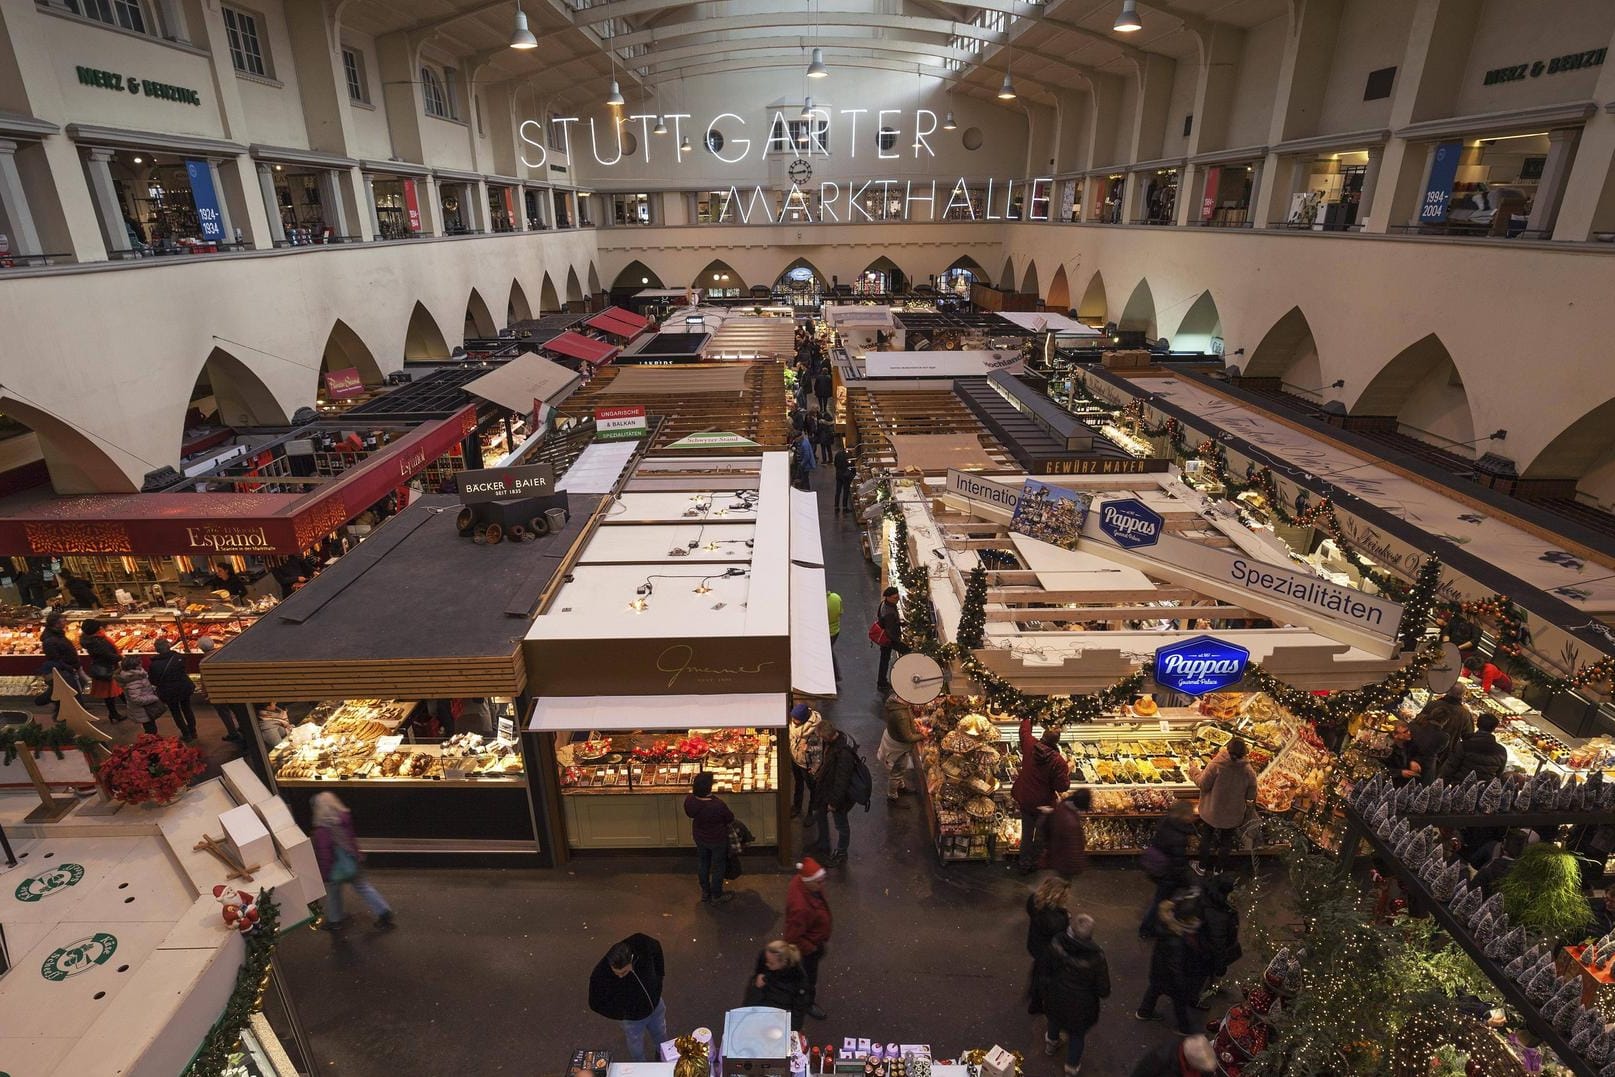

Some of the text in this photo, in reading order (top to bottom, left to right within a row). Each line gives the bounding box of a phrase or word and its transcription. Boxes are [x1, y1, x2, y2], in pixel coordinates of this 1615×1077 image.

[1483, 64, 1529, 85] MERZ
[1530, 61, 1545, 77] &
[76, 65, 201, 107] MERZ & BENZING
[519, 109, 938, 168] STUTTGARTER
[719, 176, 1053, 224] MARKTHALLE
[1426, 190, 1449, 203] 1994-
[199, 208, 220, 221] 1924-
[1422, 204, 1443, 217] 2004
[202, 222, 220, 235] 1934
[600, 409, 640, 418] UNGARISCHE
[1046, 460, 1145, 473] GEWÜRZ MAYER
[465, 477, 546, 493] BÄCKER BAIER
[956, 474, 1017, 507] Internatio
[1104, 506, 1155, 535] Pappas
[1231, 560, 1382, 625] Spezialitäten
[1164, 654, 1240, 679] Pappas
